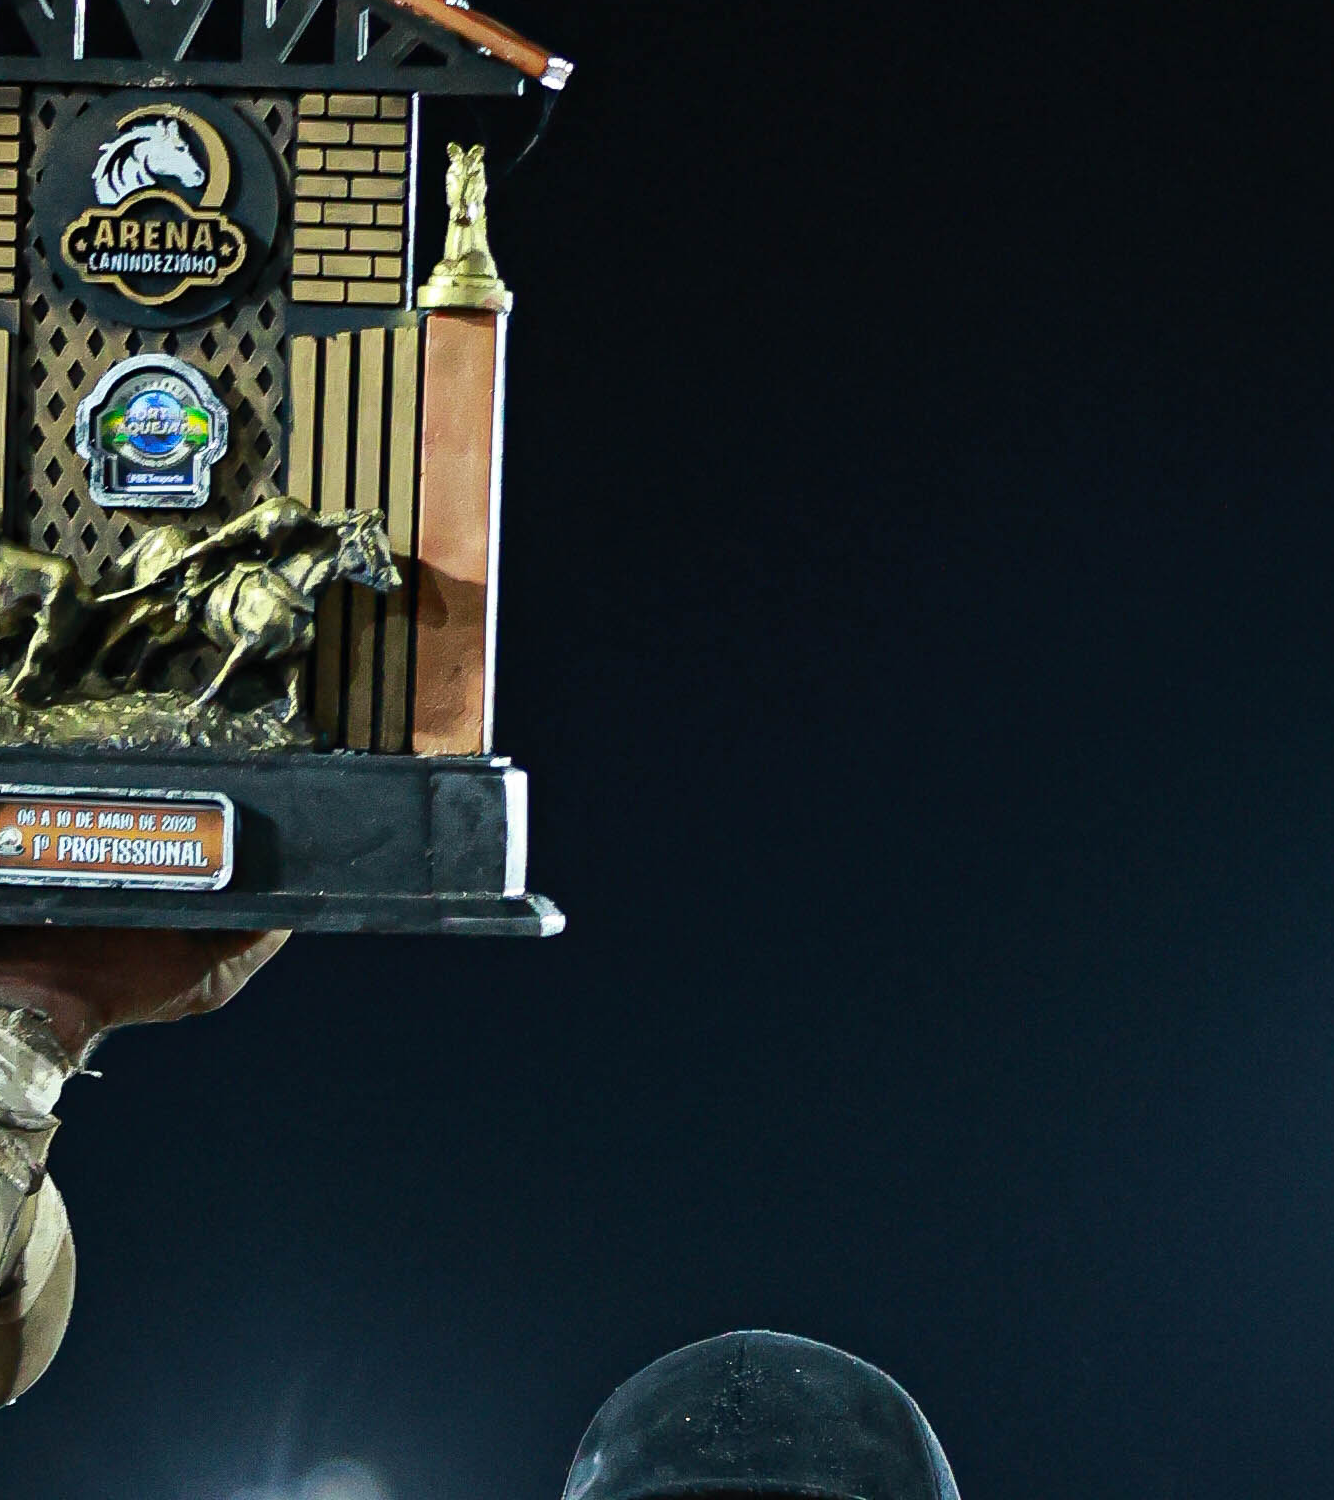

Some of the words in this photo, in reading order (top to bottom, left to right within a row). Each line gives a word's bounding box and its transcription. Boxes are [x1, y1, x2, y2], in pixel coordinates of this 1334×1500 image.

[94, 218, 214, 251] ARENA
[40, 809, 51, 827] A
[75, 811, 94, 829] DE
[98, 812, 134, 831] MAIO
[138, 814, 157, 832] DE
[57, 835, 209, 868] PROFISSIONAL
